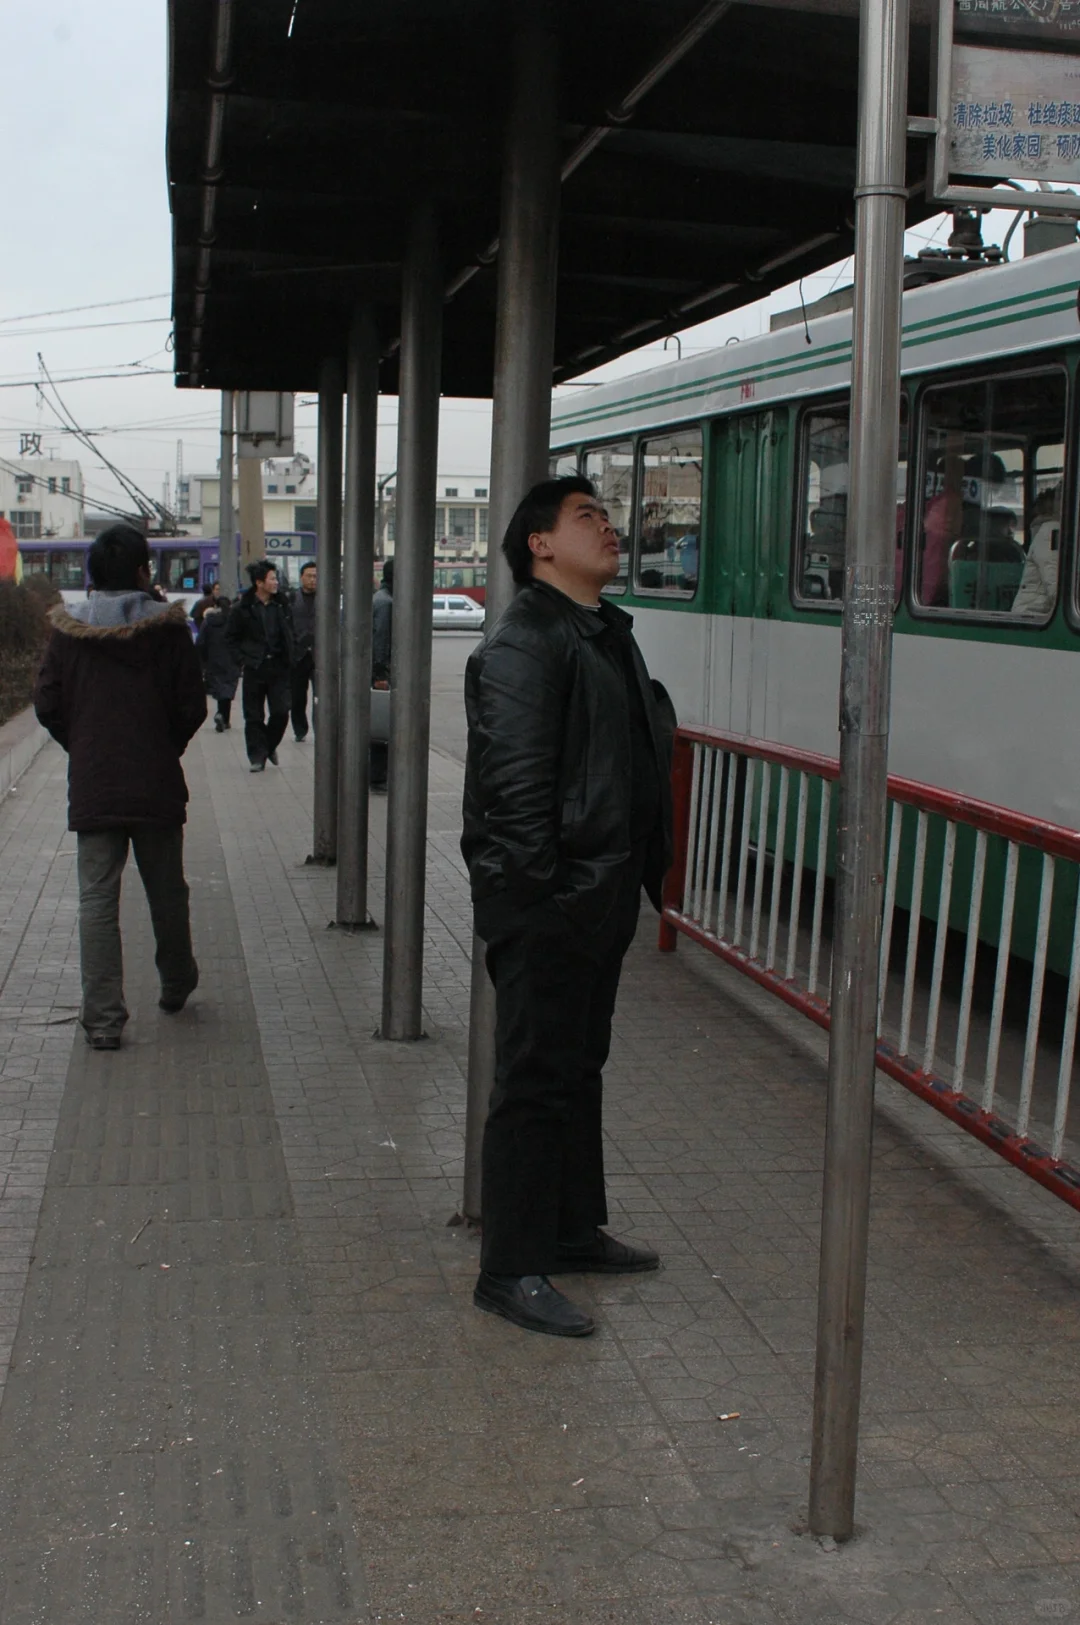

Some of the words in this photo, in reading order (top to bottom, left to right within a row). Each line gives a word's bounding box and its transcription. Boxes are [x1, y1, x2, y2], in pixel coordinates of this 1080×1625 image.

[954, 102, 1013, 127] 清除垃圾
[983, 133, 1041, 159] 美化家园
[19, 432, 43, 456] 政
[264, 538, 292, 549] 104
